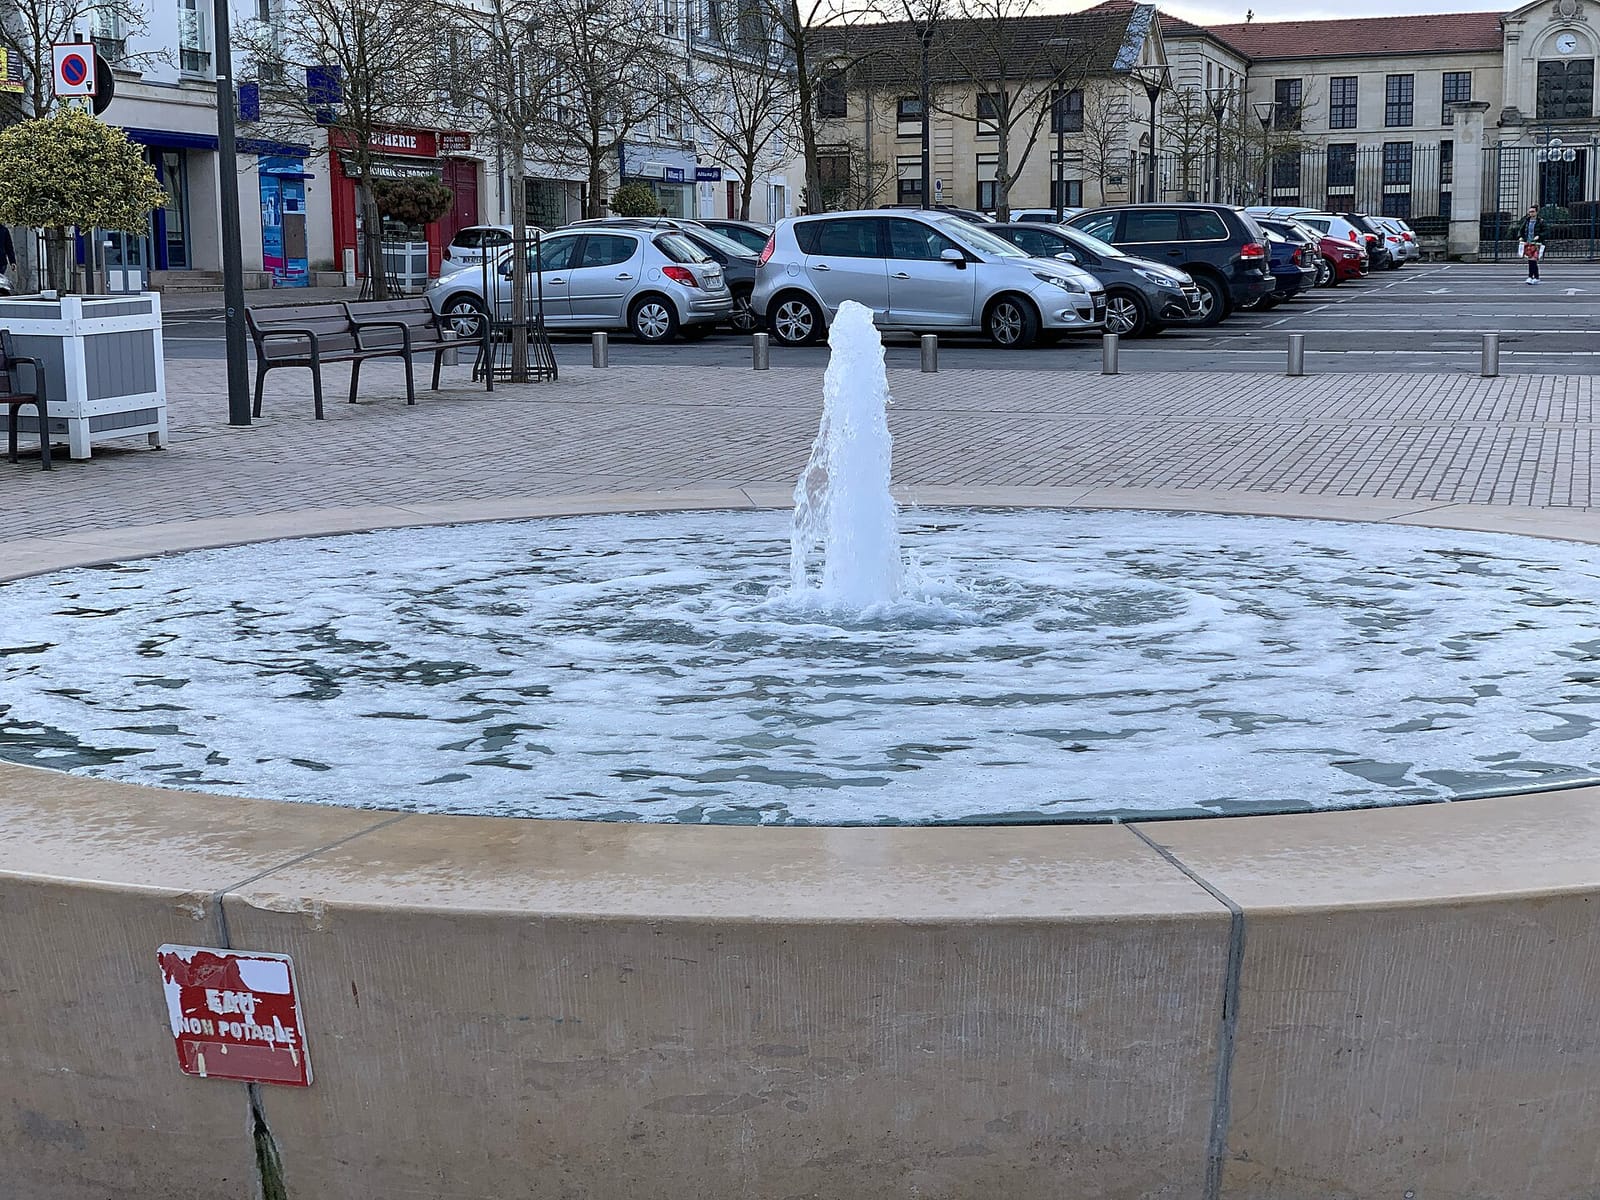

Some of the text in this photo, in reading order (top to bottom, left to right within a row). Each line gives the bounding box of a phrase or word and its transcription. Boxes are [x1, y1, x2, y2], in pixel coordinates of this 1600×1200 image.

[356, 131, 417, 149] UCHERIE
[205, 989, 256, 1015] EAU
[178, 1016, 297, 1044] NON POTABLE
